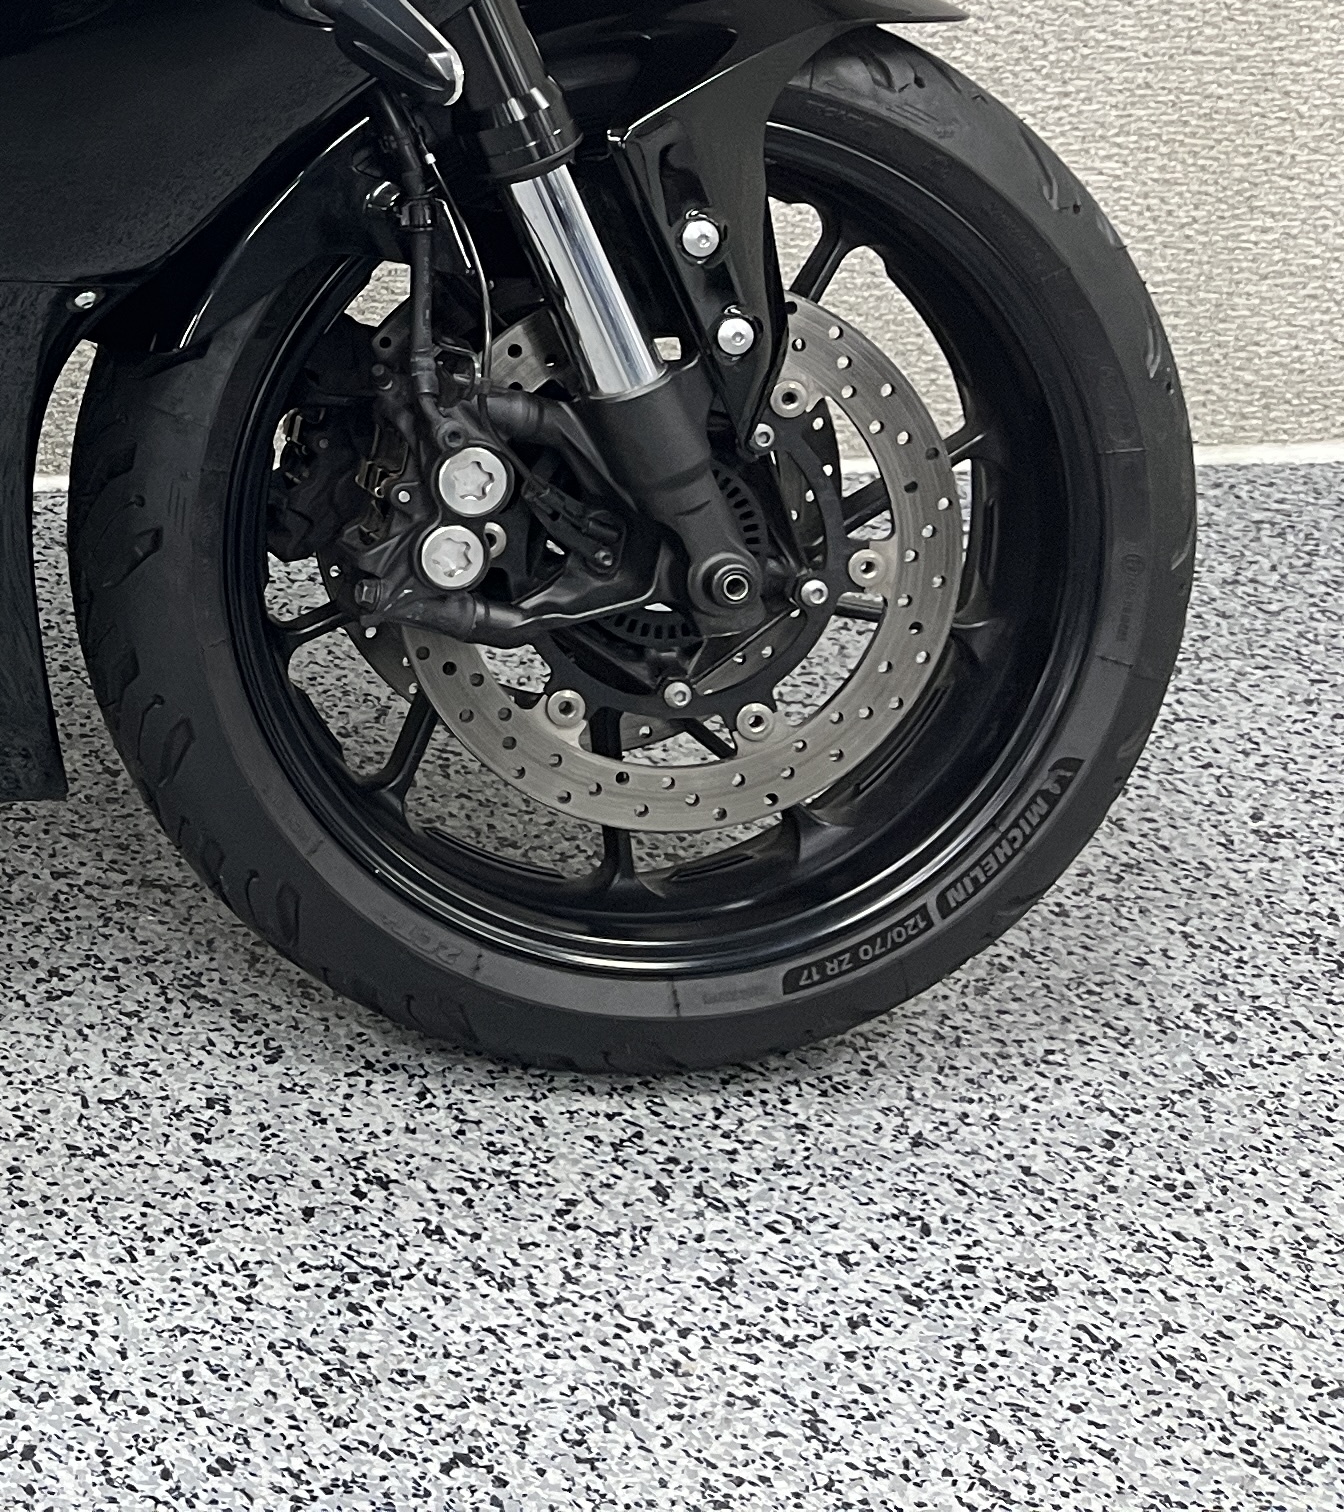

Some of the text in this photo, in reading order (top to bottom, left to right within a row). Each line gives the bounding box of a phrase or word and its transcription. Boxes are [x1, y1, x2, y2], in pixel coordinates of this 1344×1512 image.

[798, 795, 1050, 986] MICHELIN 120/70 ZR 17
